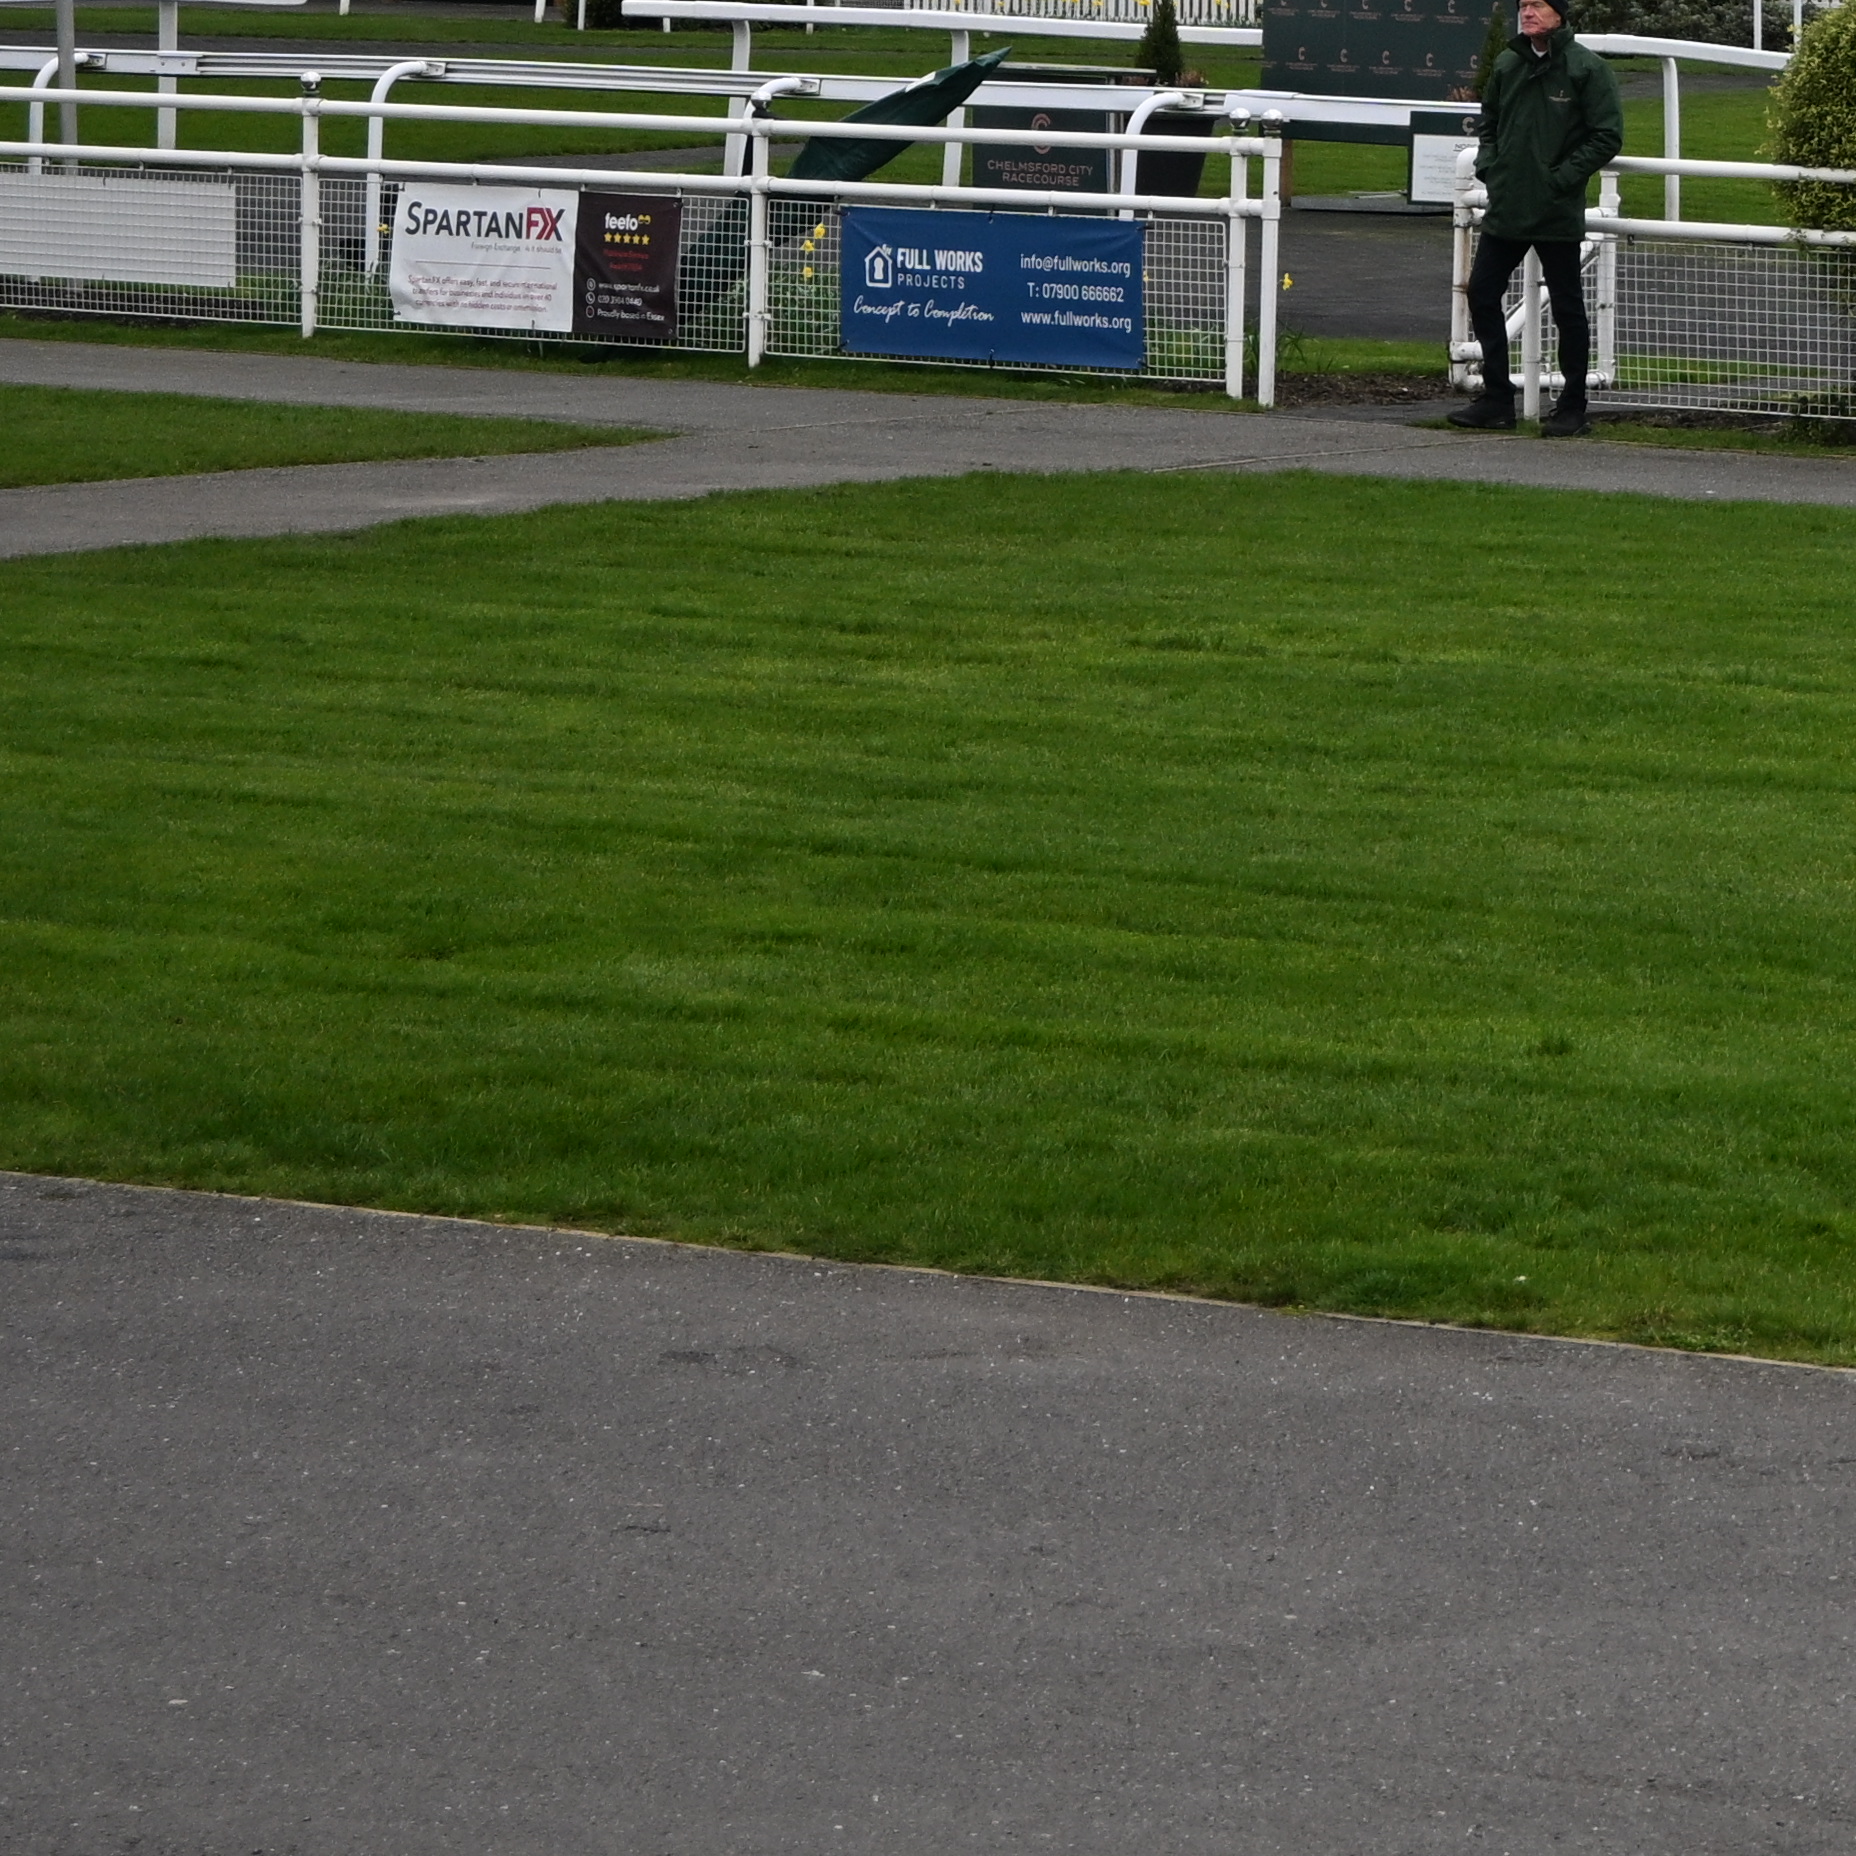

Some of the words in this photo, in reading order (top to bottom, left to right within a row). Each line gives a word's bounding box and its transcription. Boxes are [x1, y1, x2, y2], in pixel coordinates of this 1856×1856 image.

[987, 159, 1066, 174] CHELMSFORD
[1069, 165, 1093, 176] CITY
[1002, 172, 1080, 186] RACECOURSE
[604, 212, 639, 231] feefo
[896, 247, 931, 270] FULL
[934, 249, 984, 273] WORKS
[1020, 253, 1131, 278] info@fullworks.org
[897, 273, 965, 290] PROJECTS
[1026, 282, 1040, 298] T:
[1042, 283, 1079, 300] 07900
[1081, 285, 1125, 303] 666662
[853, 294, 905, 324] Concept
[907, 303, 921, 318] to
[923, 298, 995, 328] Completion
[1020, 310, 1132, 334] www.fullworks.org
